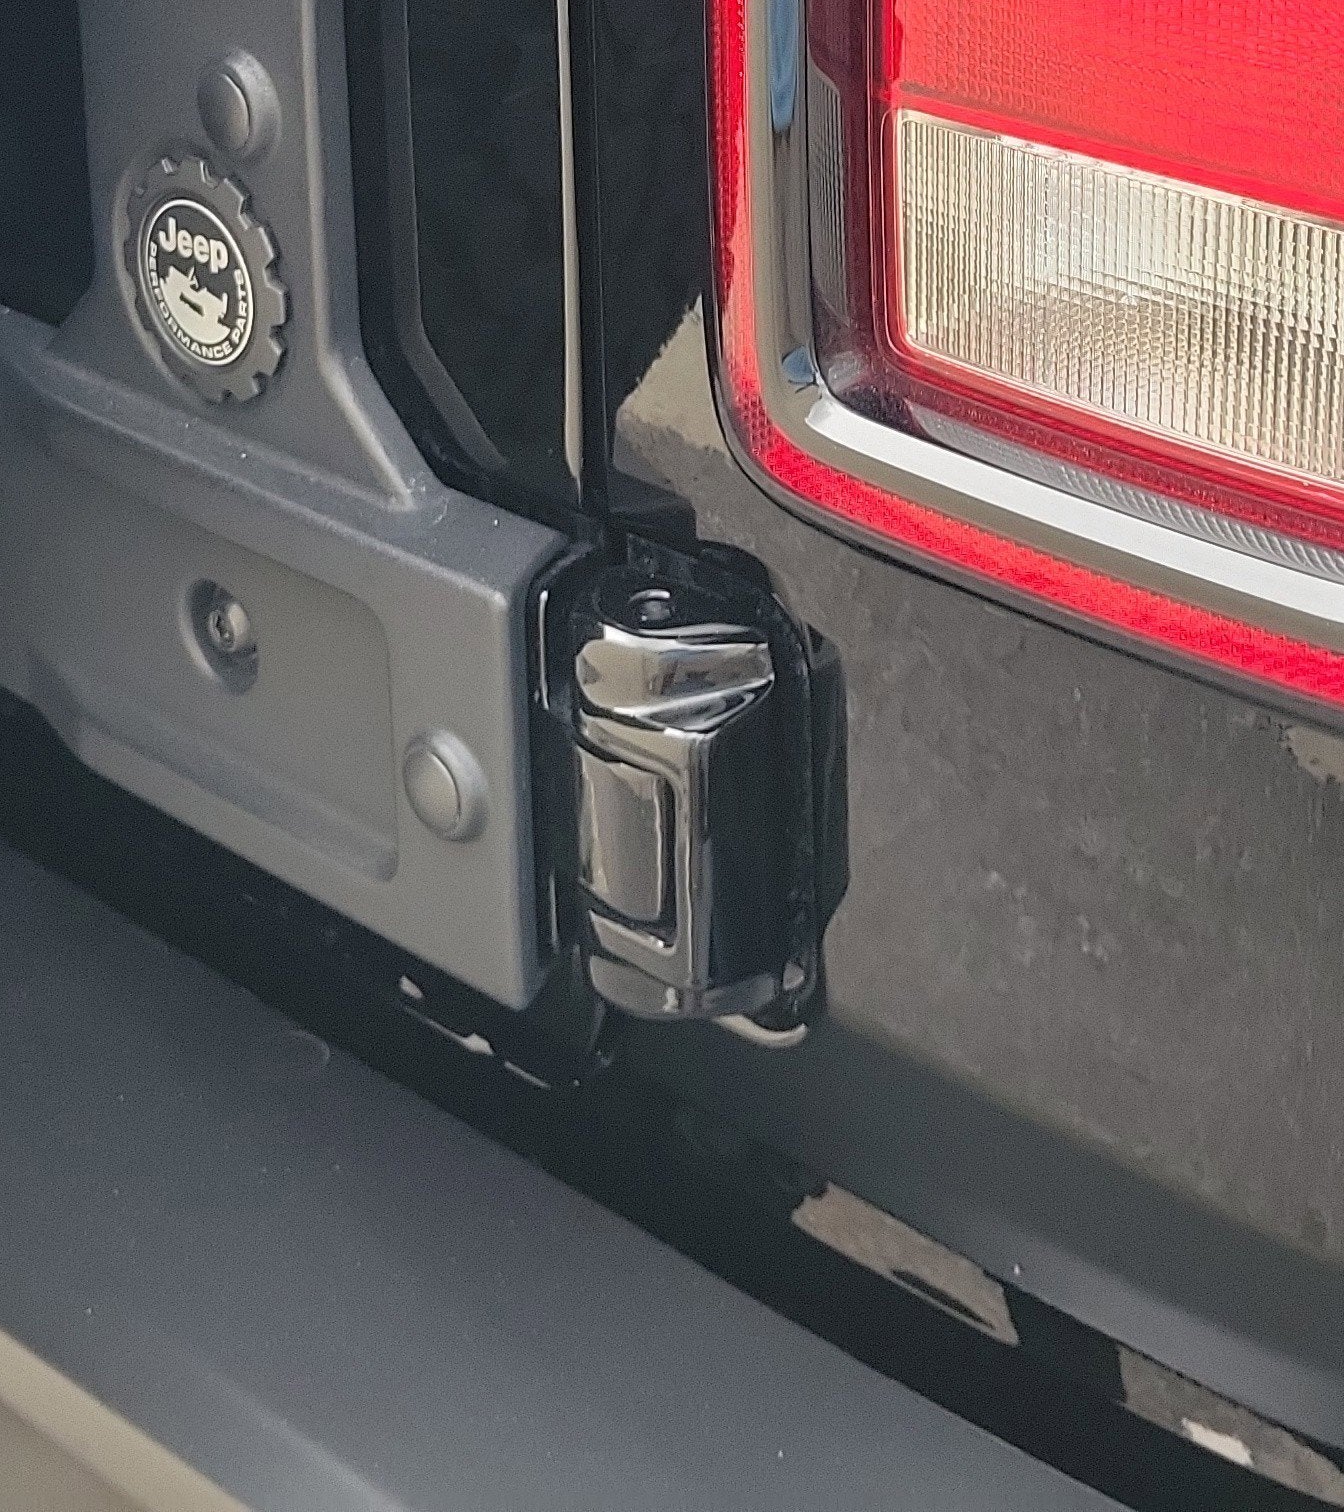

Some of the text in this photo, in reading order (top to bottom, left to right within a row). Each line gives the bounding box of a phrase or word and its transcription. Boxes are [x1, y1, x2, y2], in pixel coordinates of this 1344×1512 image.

[158, 217, 229, 274] Jeep
[149, 241, 248, 359] PERFORMANCE PARTS
